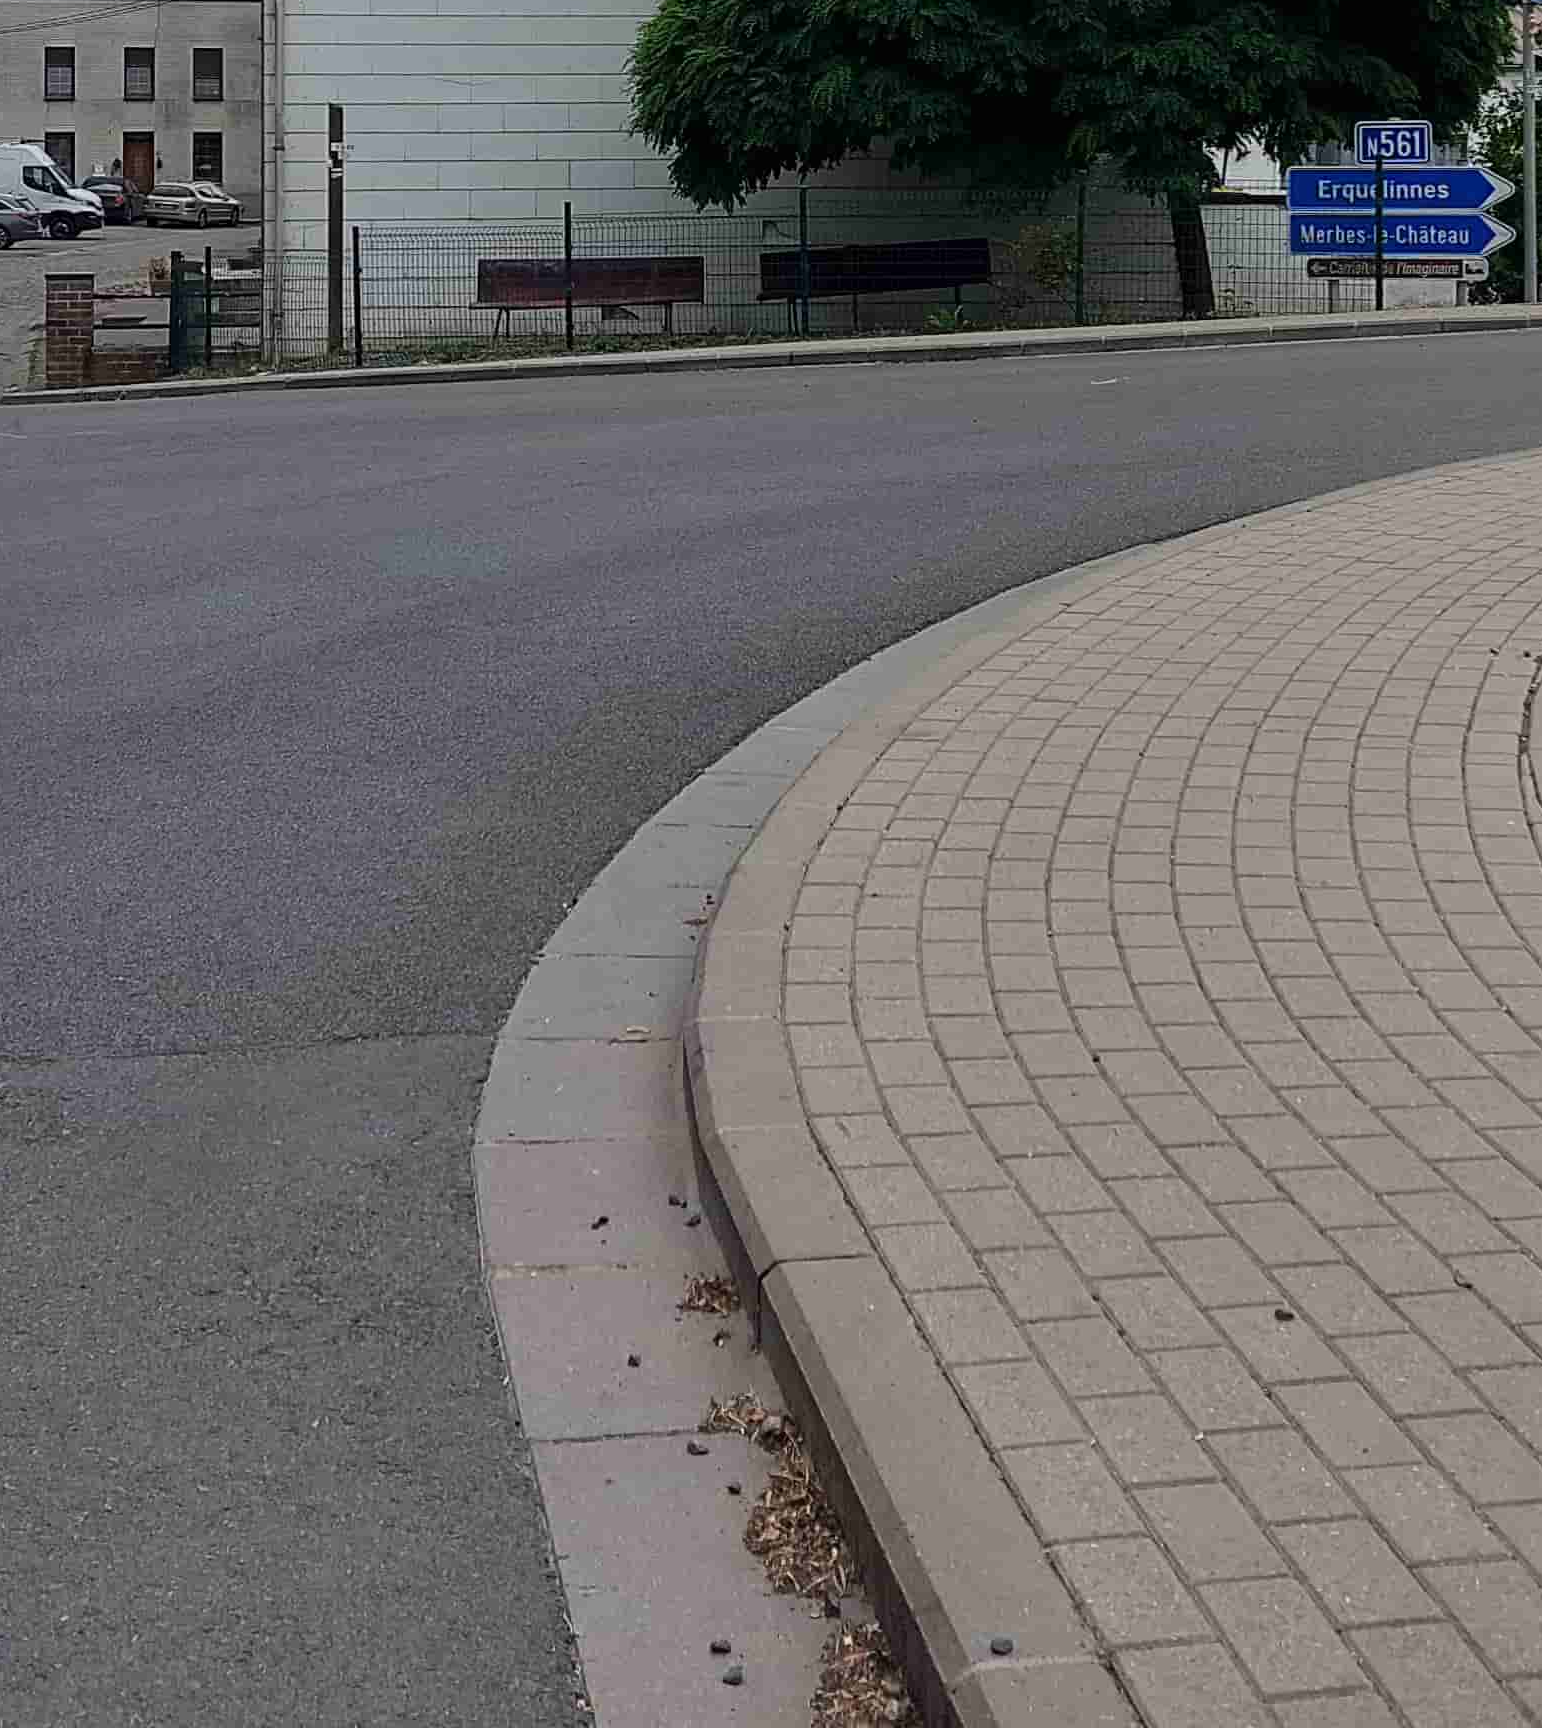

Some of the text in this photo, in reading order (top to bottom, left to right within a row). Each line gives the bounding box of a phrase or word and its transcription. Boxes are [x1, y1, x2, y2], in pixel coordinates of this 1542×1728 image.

[1367, 131, 1420, 157] N561
[1318, 179, 1450, 203] Erquelinnes
[1300, 224, 1470, 245] Merbes-le-Château
